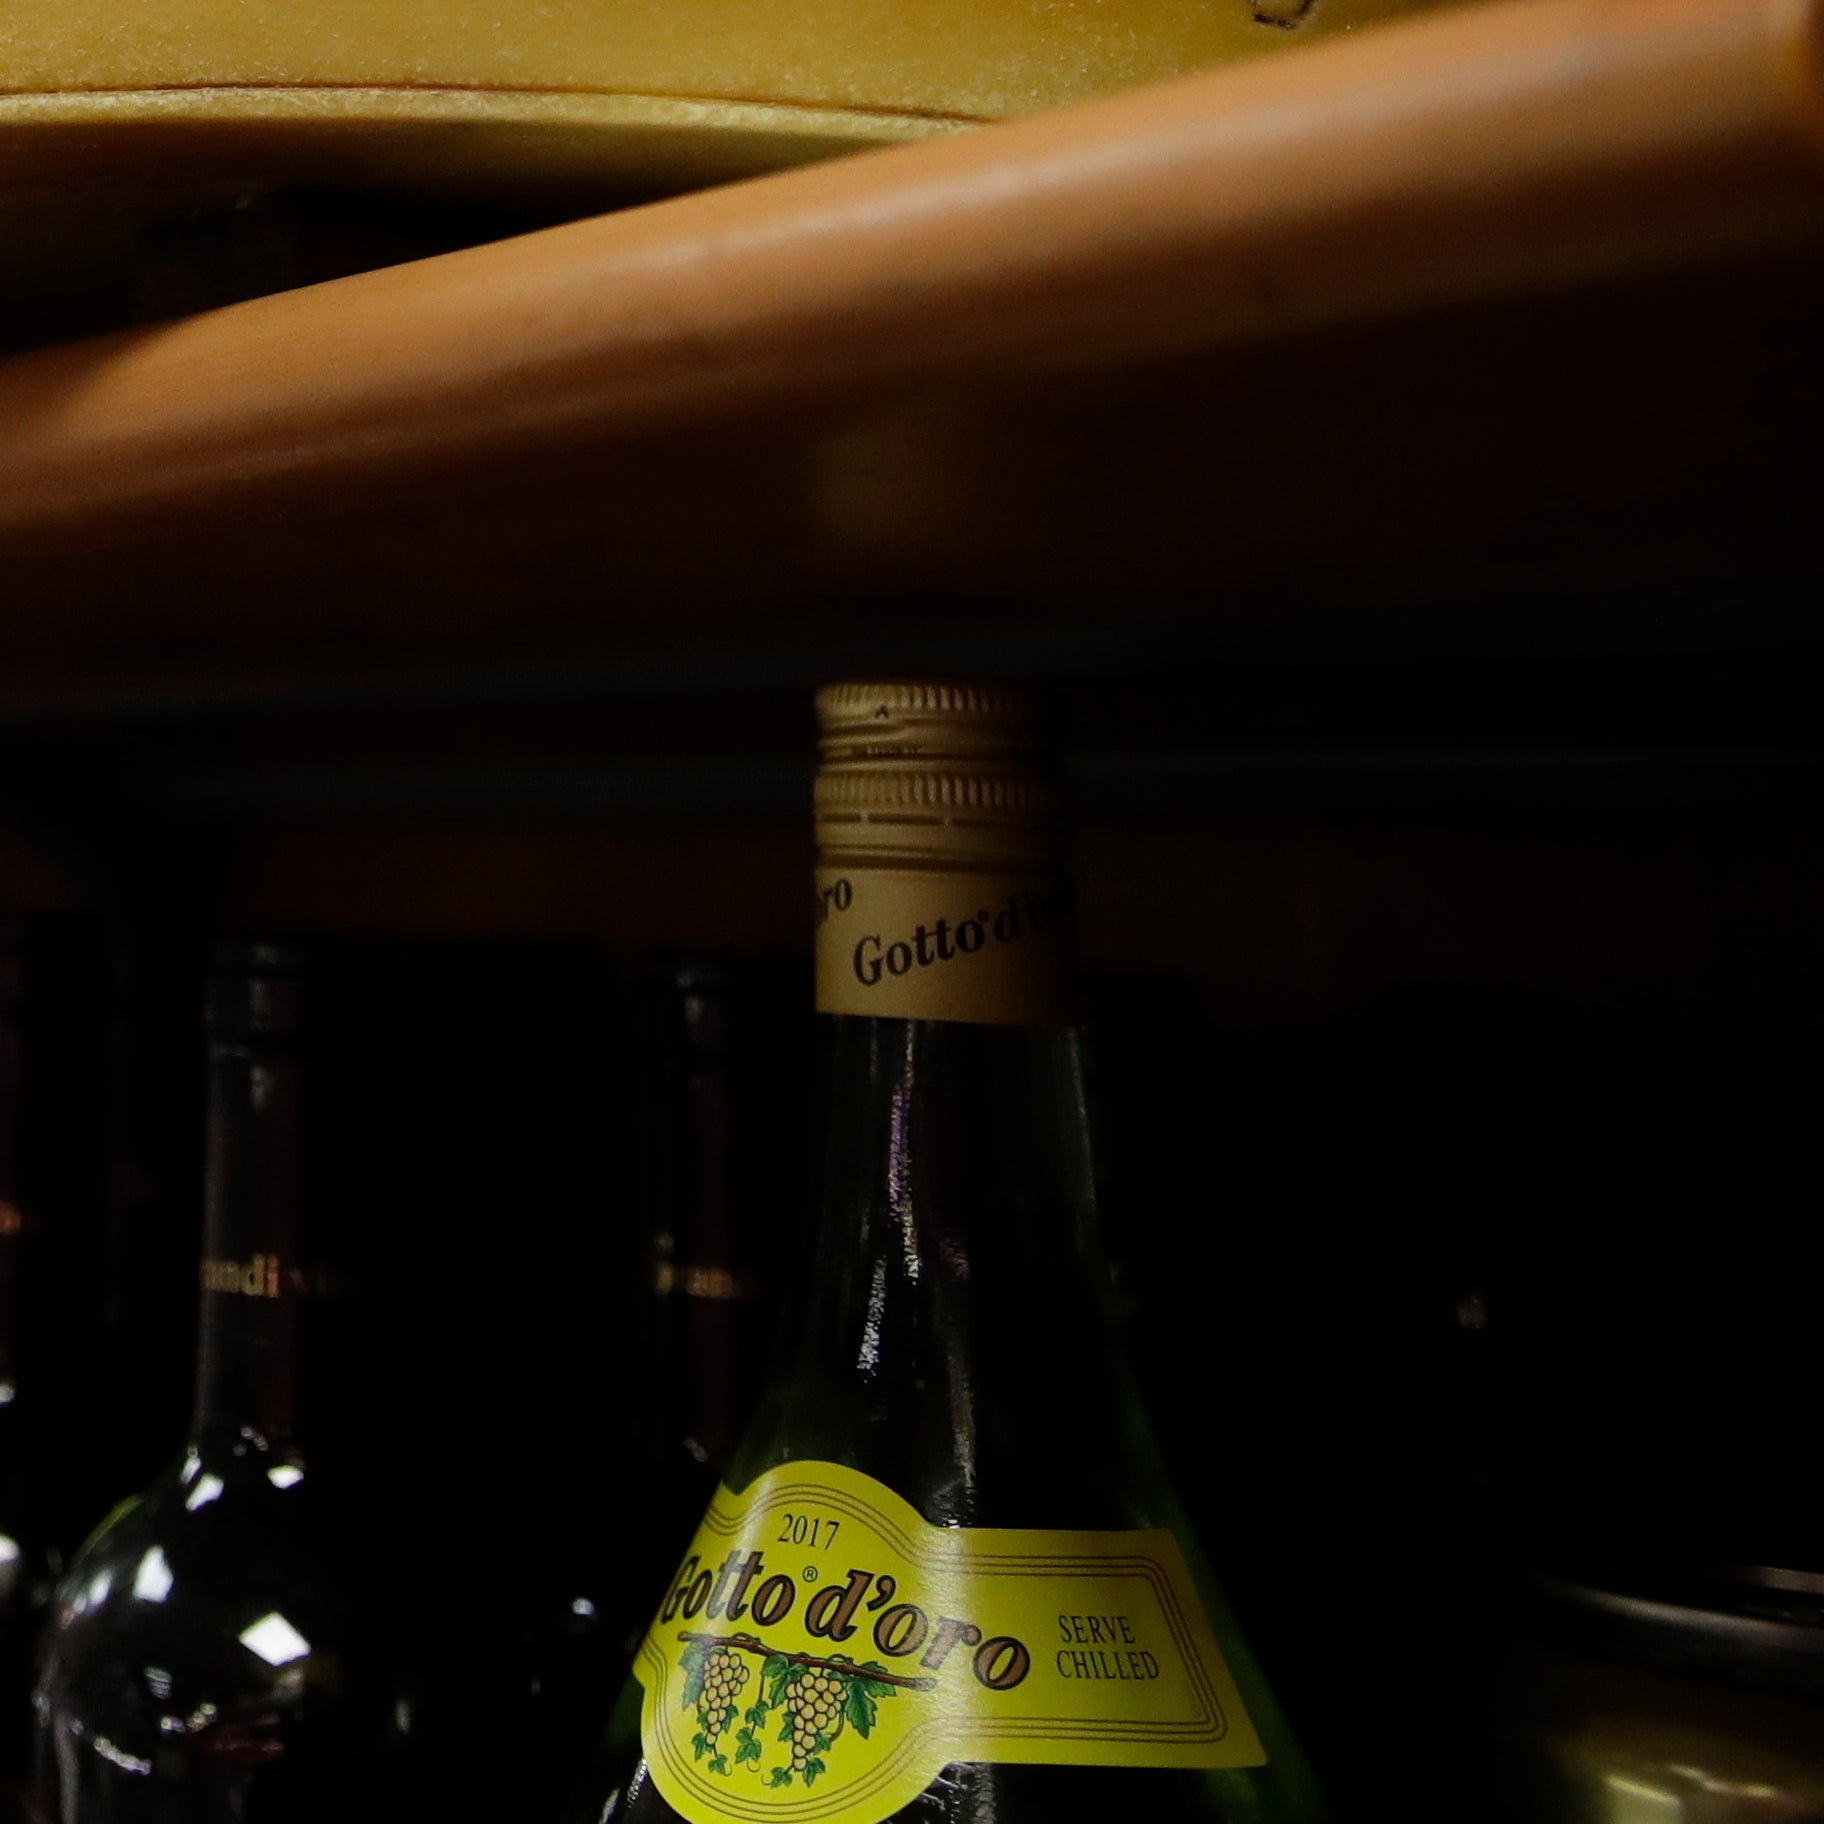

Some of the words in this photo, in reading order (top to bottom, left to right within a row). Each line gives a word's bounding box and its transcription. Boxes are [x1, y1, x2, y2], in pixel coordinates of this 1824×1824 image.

[853, 918, 986, 988] Gotto
[776, 1512, 840, 1551] 2017
[803, 1568, 1032, 1692] d'oro
[1057, 1614, 1136, 1644] SERVE
[1056, 1649, 1160, 1681] CHILLED
